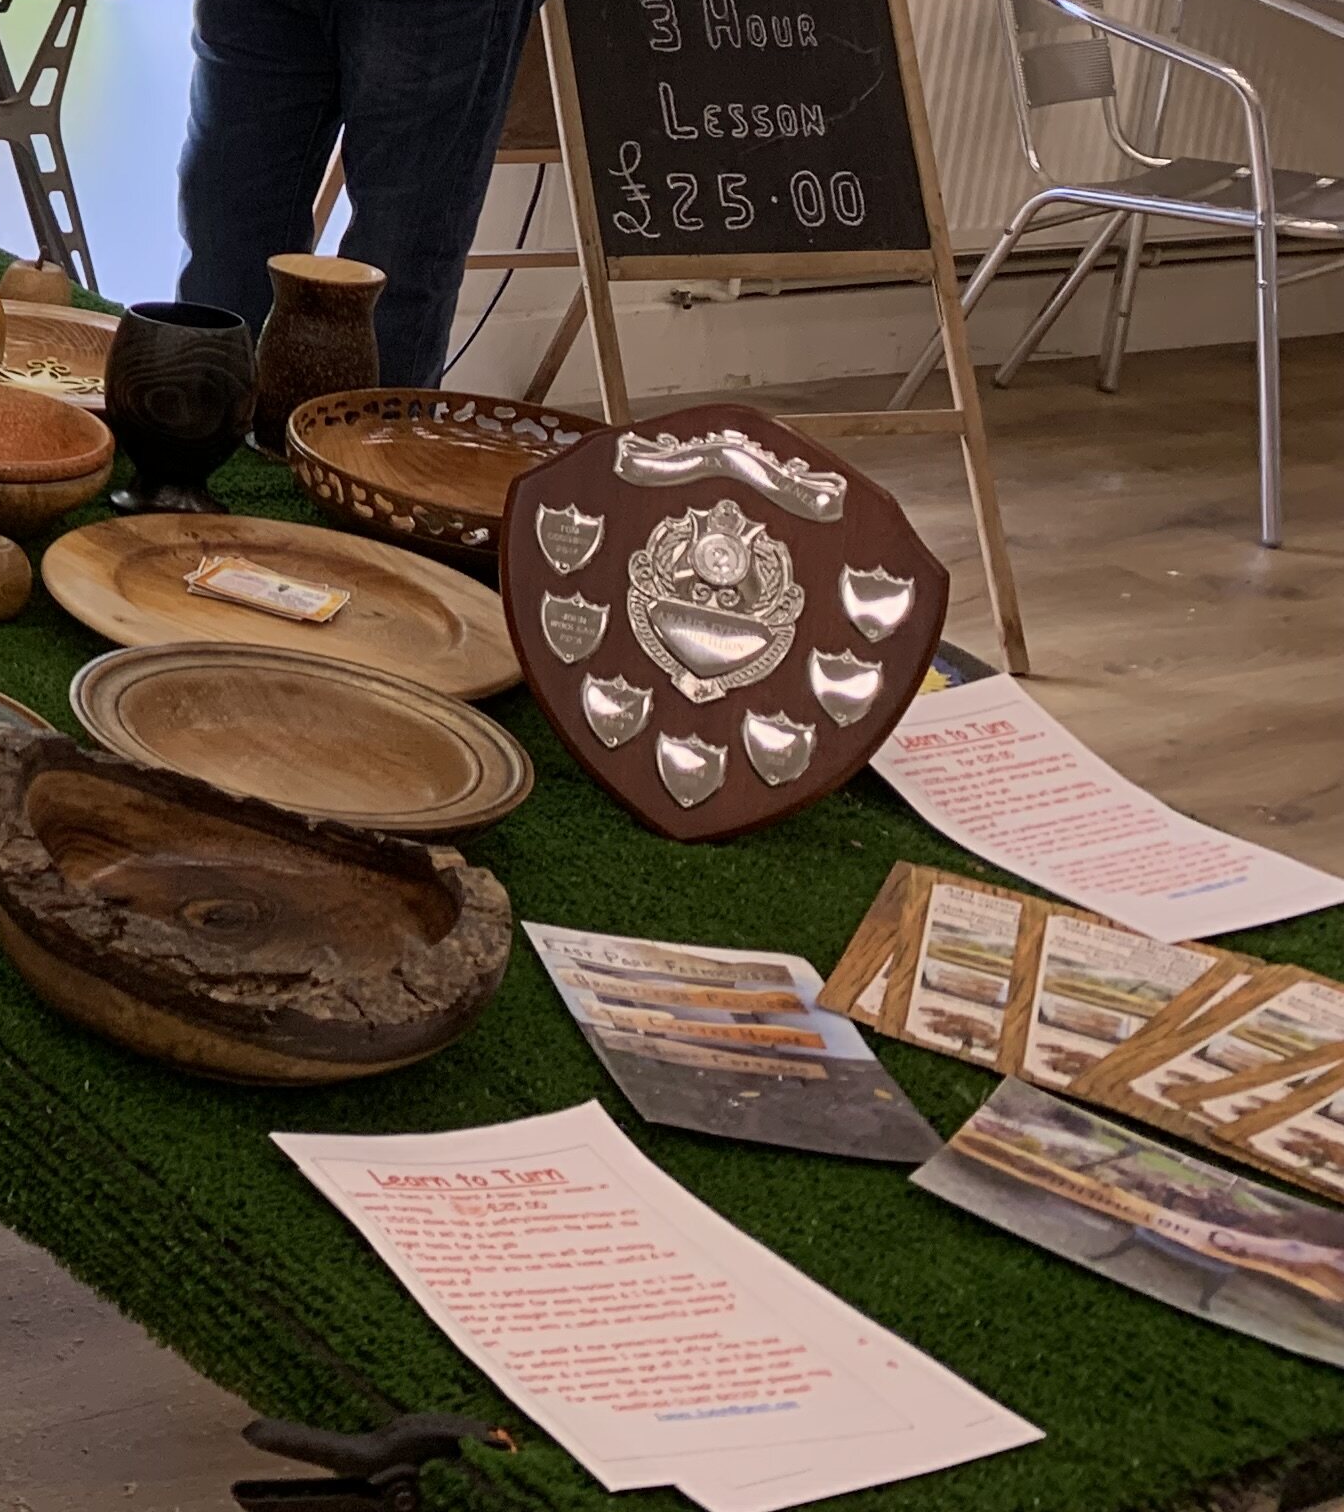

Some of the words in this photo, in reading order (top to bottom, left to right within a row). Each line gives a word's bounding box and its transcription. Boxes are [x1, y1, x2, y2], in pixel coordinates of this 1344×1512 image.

[658, 82, 826, 141] LESSON
[893, 732, 946, 750] Learn
[945, 729, 968, 740] to
[965, 720, 1016, 736] Turn
[367, 1169, 451, 1188] Learn
[455, 1173, 488, 1187] to
[490, 1168, 566, 1184] Turn
